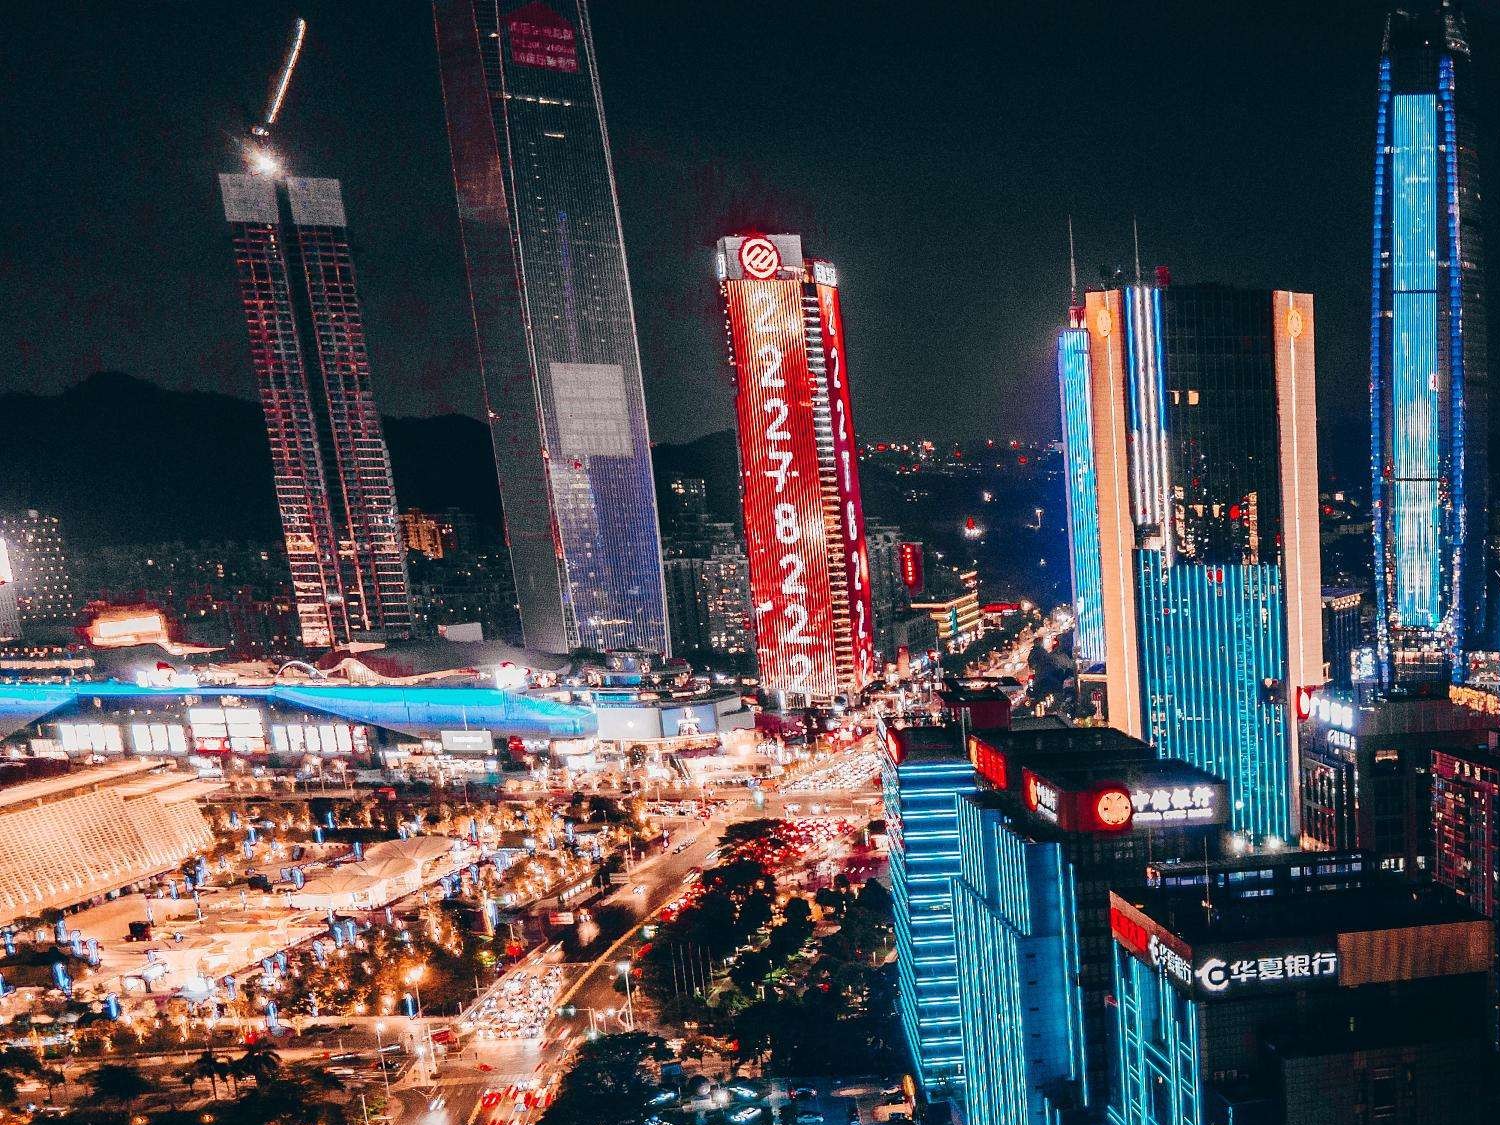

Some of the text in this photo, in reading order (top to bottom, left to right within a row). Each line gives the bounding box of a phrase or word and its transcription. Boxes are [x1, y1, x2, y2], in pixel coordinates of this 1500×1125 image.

[1159, 943, 1192, 985] 华夏银行
[1230, 952, 1338, 982] 华夏银行
